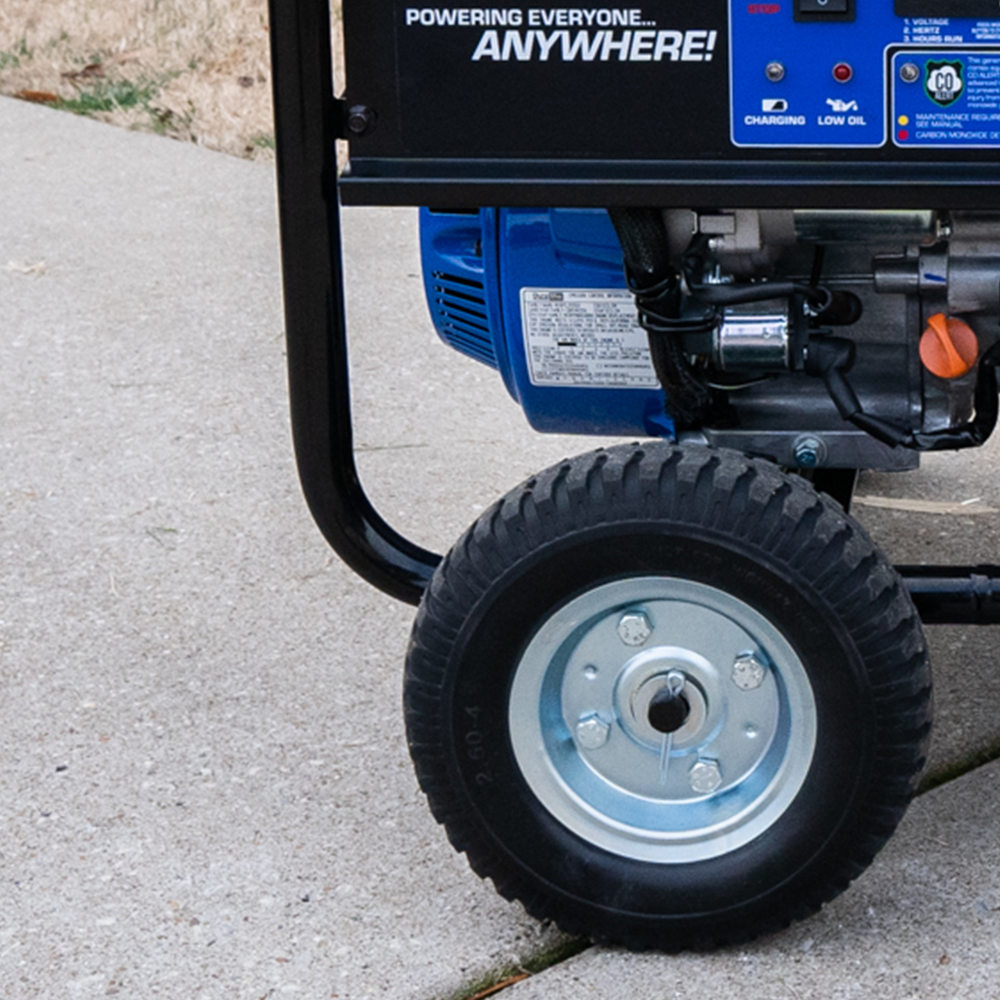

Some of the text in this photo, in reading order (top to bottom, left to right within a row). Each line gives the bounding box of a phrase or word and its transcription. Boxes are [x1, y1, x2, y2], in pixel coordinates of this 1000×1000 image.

[405, 8, 657, 27] POWERING EVERYONE...
[912, 18, 949, 26] VOLTAGE
[912, 26, 940, 35] HERTZ
[471, 29, 718, 62] ANYWHERE!
[935, 72, 954, 91] CO
[744, 115, 806, 126] CHARGING
[817, 115, 867, 126] LOW OIL
